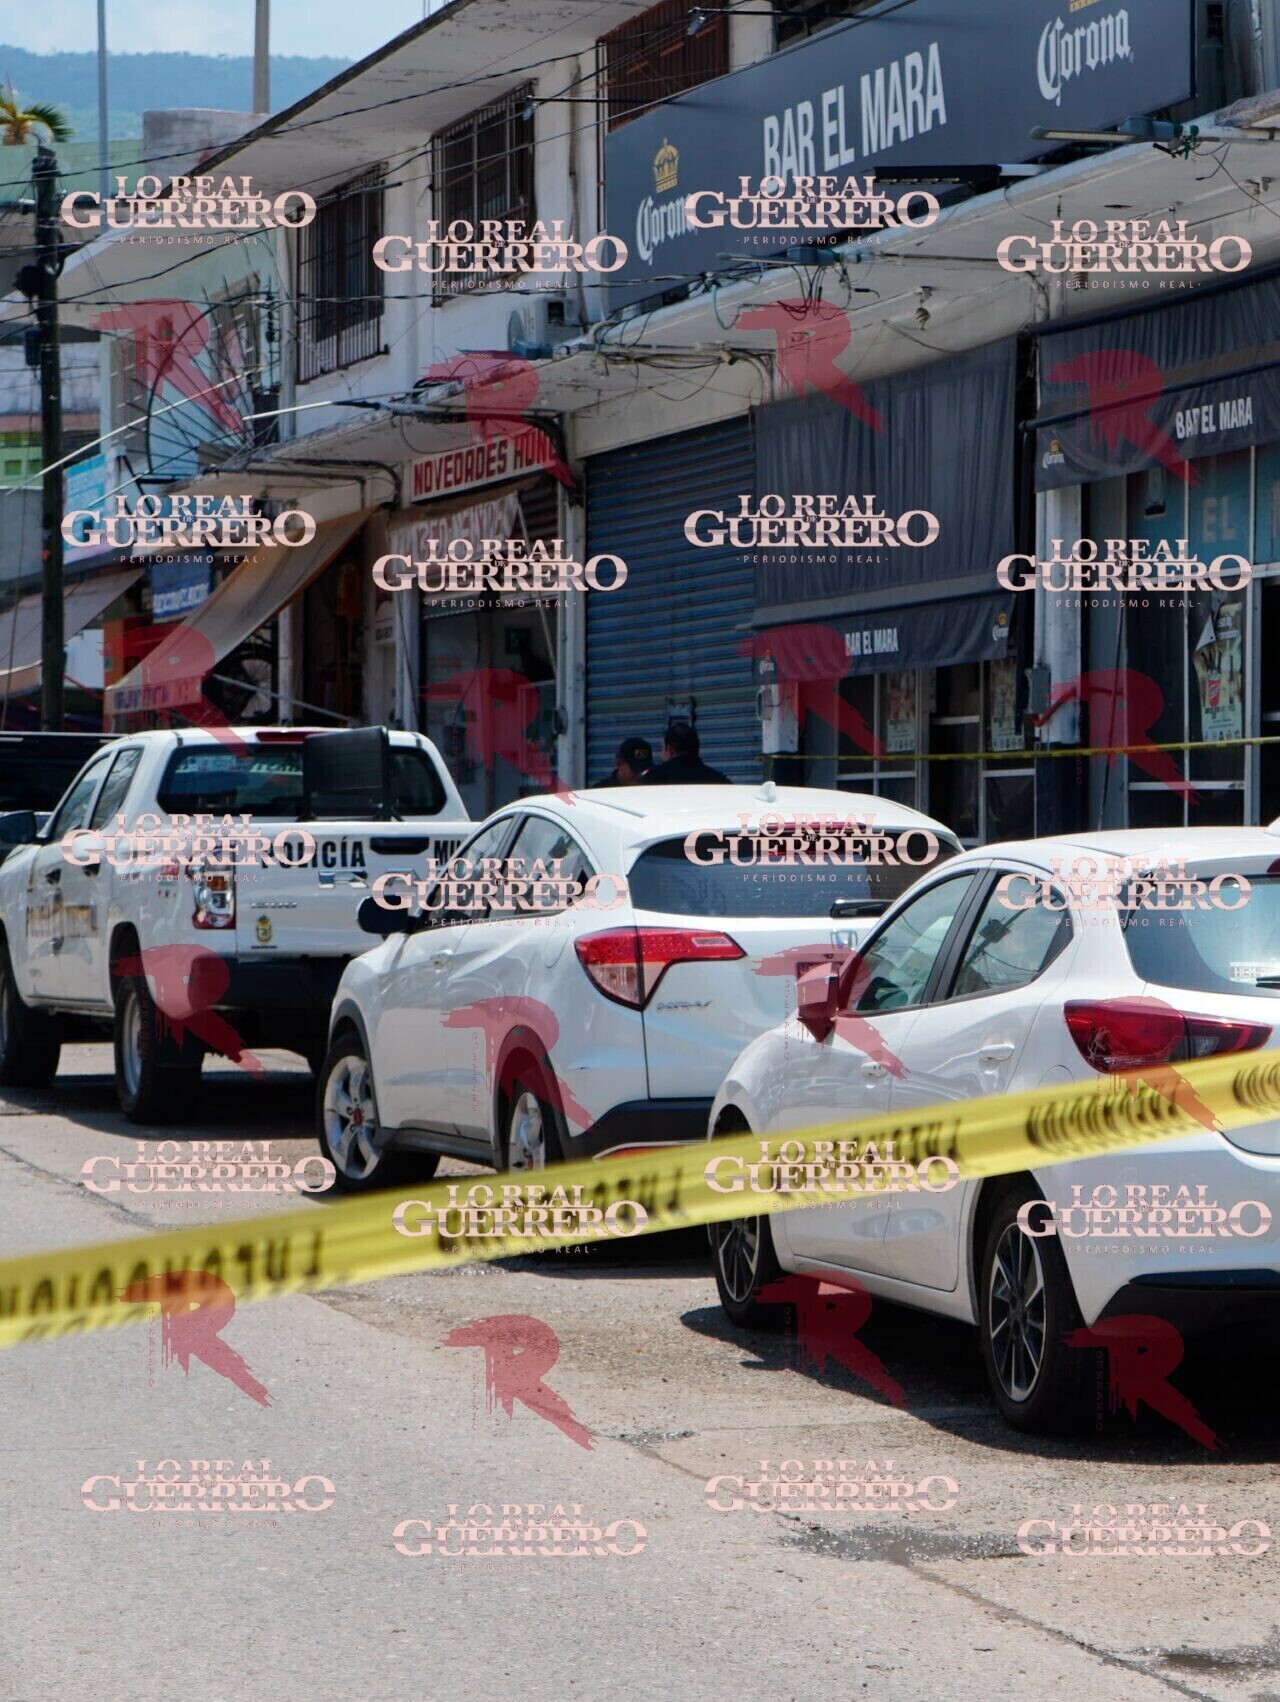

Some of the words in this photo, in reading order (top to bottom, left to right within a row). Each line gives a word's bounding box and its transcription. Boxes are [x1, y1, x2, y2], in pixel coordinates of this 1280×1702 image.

[1037, 8, 1131, 107] Corona
[764, 100, 816, 193] BAR
[822, 85, 855, 172] EL
[860, 42, 947, 157] MARA
[636, 195, 698, 266] Coron
[1201, 405, 1217, 434] EL
[1219, 397, 1253, 430] MARA
[414, 439, 508, 496] NOVEDADES
[1203, 495, 1237, 544] EL
[863, 631, 873, 653] EL
[874, 627, 899, 652] MARA
